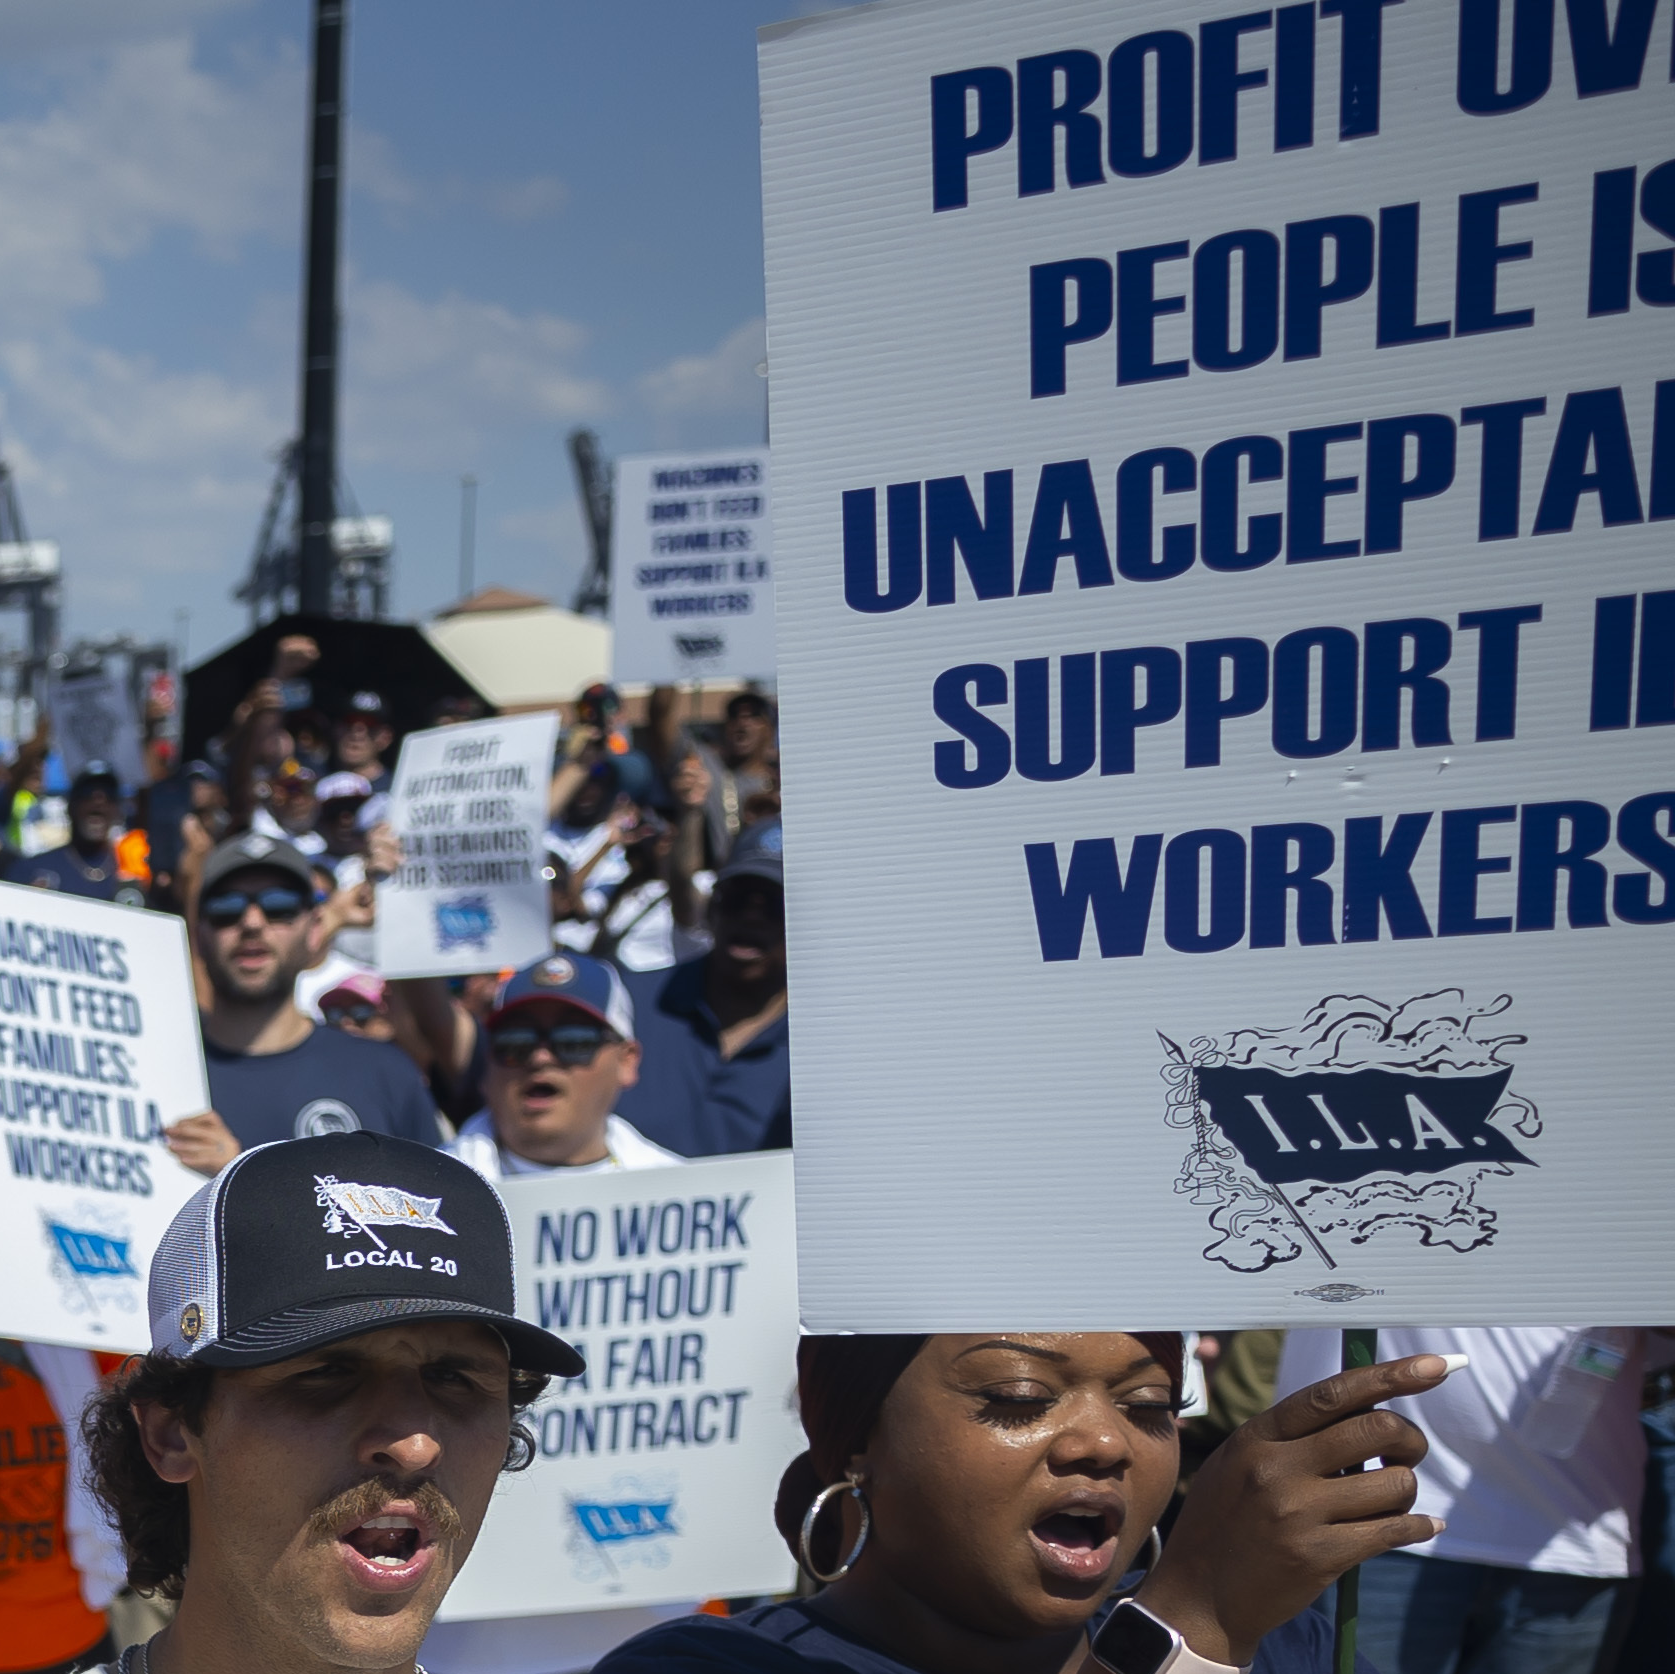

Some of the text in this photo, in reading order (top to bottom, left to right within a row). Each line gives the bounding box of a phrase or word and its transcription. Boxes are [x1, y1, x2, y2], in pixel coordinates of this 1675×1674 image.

[931, 0, 1675, 213] PROFIT OV
[1029, 181, 1540, 400] PEOPLE
[932, 603, 1543, 790] SUPPORT
[1024, 791, 1675, 963] WORKERS
[67, 983, 142, 1038] FEED
[119, 1098, 167, 1144] ILA
[4, 1132, 155, 1197] WORKERS
[326, 1250, 458, 1276] LOCAL 20
[534, 1191, 754, 1266] NO WORK
[534, 1261, 746, 1330] WITHOUT
[602, 1331, 706, 1392] FAIR
[527, 1389, 752, 1459] ONTRACT
